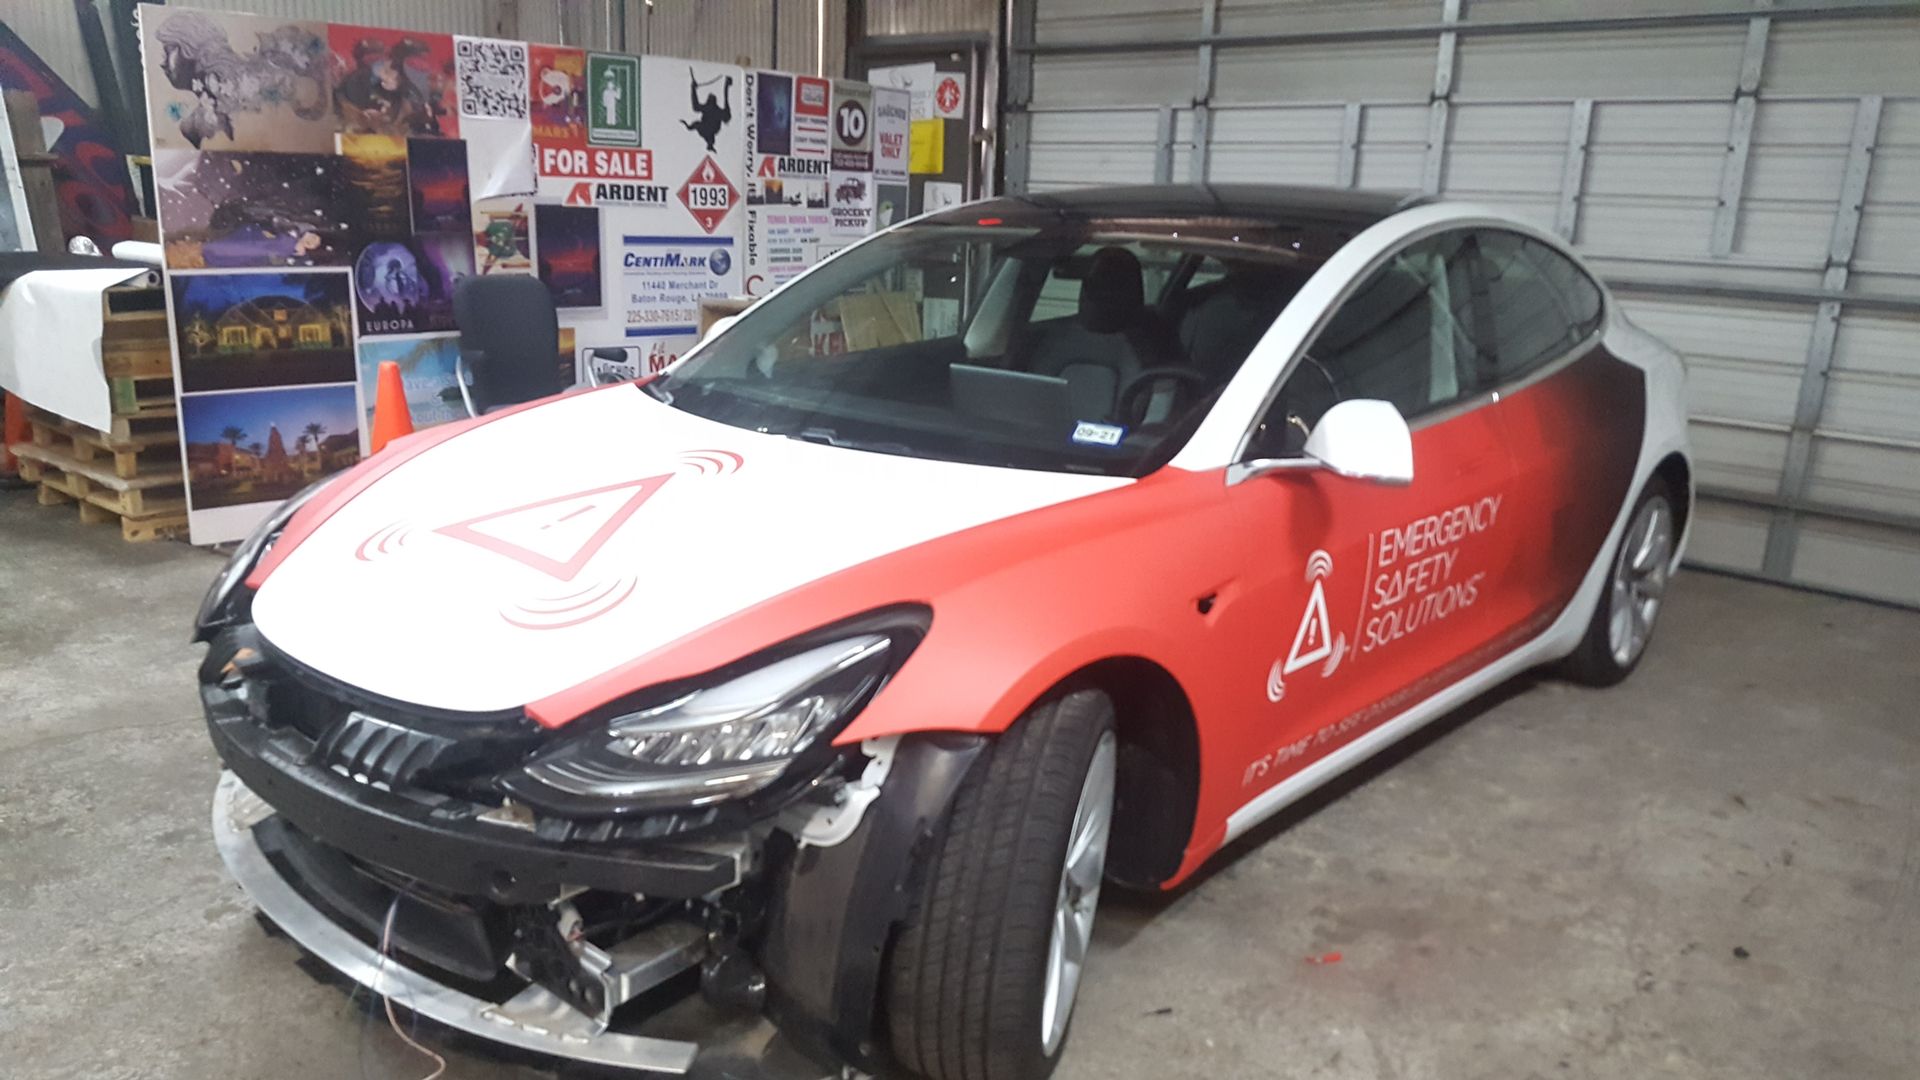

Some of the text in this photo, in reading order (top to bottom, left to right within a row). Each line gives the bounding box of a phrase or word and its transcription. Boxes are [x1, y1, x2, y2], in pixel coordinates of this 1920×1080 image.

[745, 74, 755, 118] Don't
[840, 107, 865, 138] 10
[879, 132, 903, 146] VALET
[543, 148, 649, 177] FOR SALE
[745, 124, 756, 178] Worry,
[778, 157, 830, 175] ARDENT
[595, 183, 669, 203] ARDENT
[691, 187, 727, 210] 1993
[705, 216, 713, 228] 3
[831, 207, 872, 217] GROCERY
[835, 217, 868, 228] PICKUP
[747, 210, 758, 266] Fixable
[668, 279, 706, 290] Merchant
[708, 279, 719, 290] Dr
[631, 292, 657, 304] Baton
[365, 319, 415, 332] EUROPA
[1377, 494, 1502, 567] EMERGENCY
[1371, 548, 1459, 610] SAFETY
[1362, 580, 1480, 652] SOLUTIONS
[1242, 754, 1273, 788] IT'S
[1273, 734, 1314, 768] TIME
